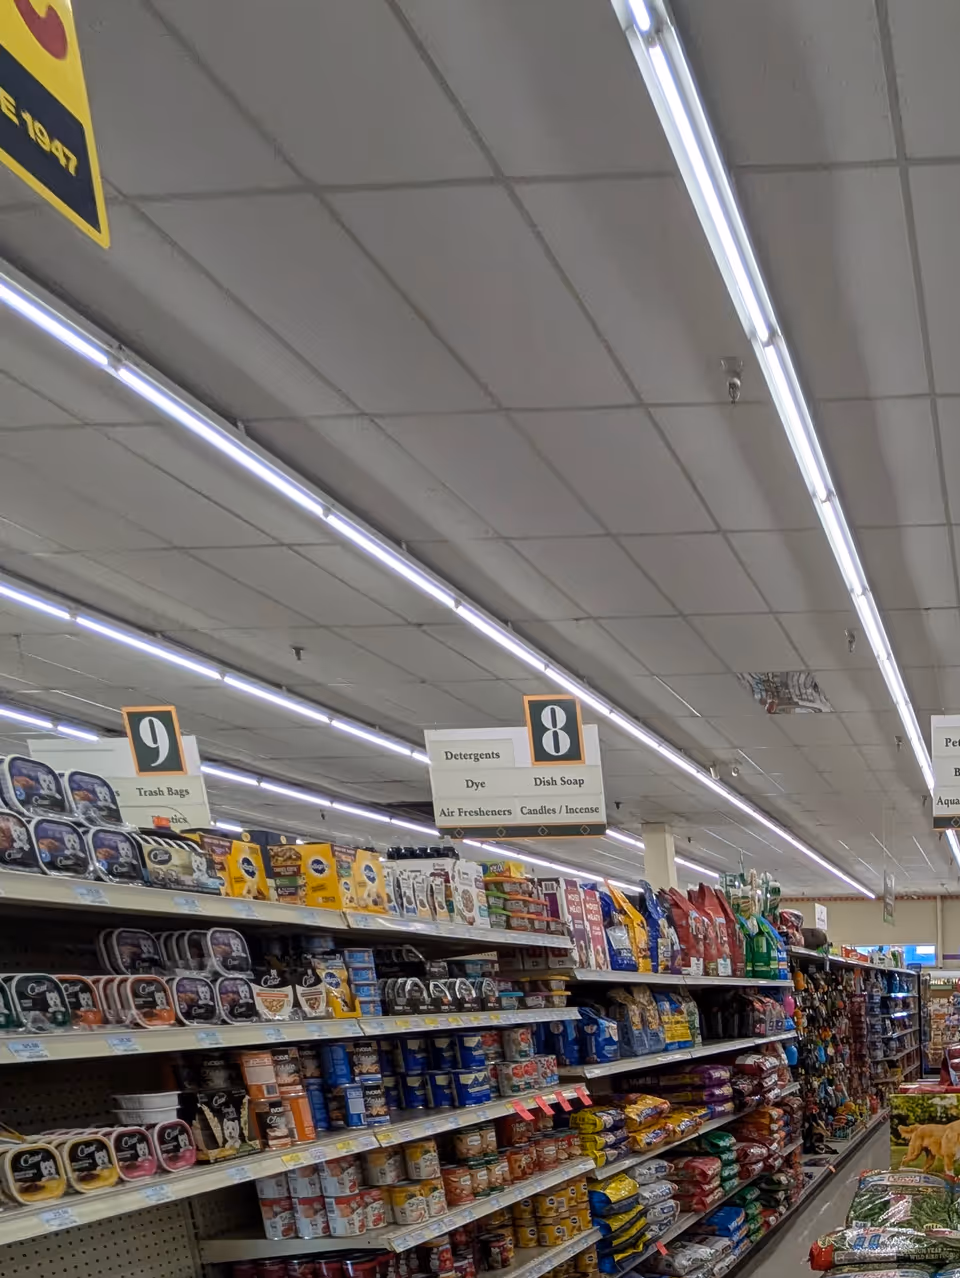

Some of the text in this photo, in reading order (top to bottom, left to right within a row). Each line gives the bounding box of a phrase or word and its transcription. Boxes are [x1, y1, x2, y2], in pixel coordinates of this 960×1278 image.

[21, 108, 79, 177] 1947
[540, 704, 571, 756] 8
[138, 715, 170, 768] 9
[444, 750, 500, 762] Detergents
[465, 779, 486, 791] Dye
[533, 776, 585, 788] Dish Soap
[136, 786, 190, 798] Trash Bags
[439, 807, 513, 818] Air Fresheners
[520, 805, 557, 816] Candles
[565, 804, 600, 815] Incense
